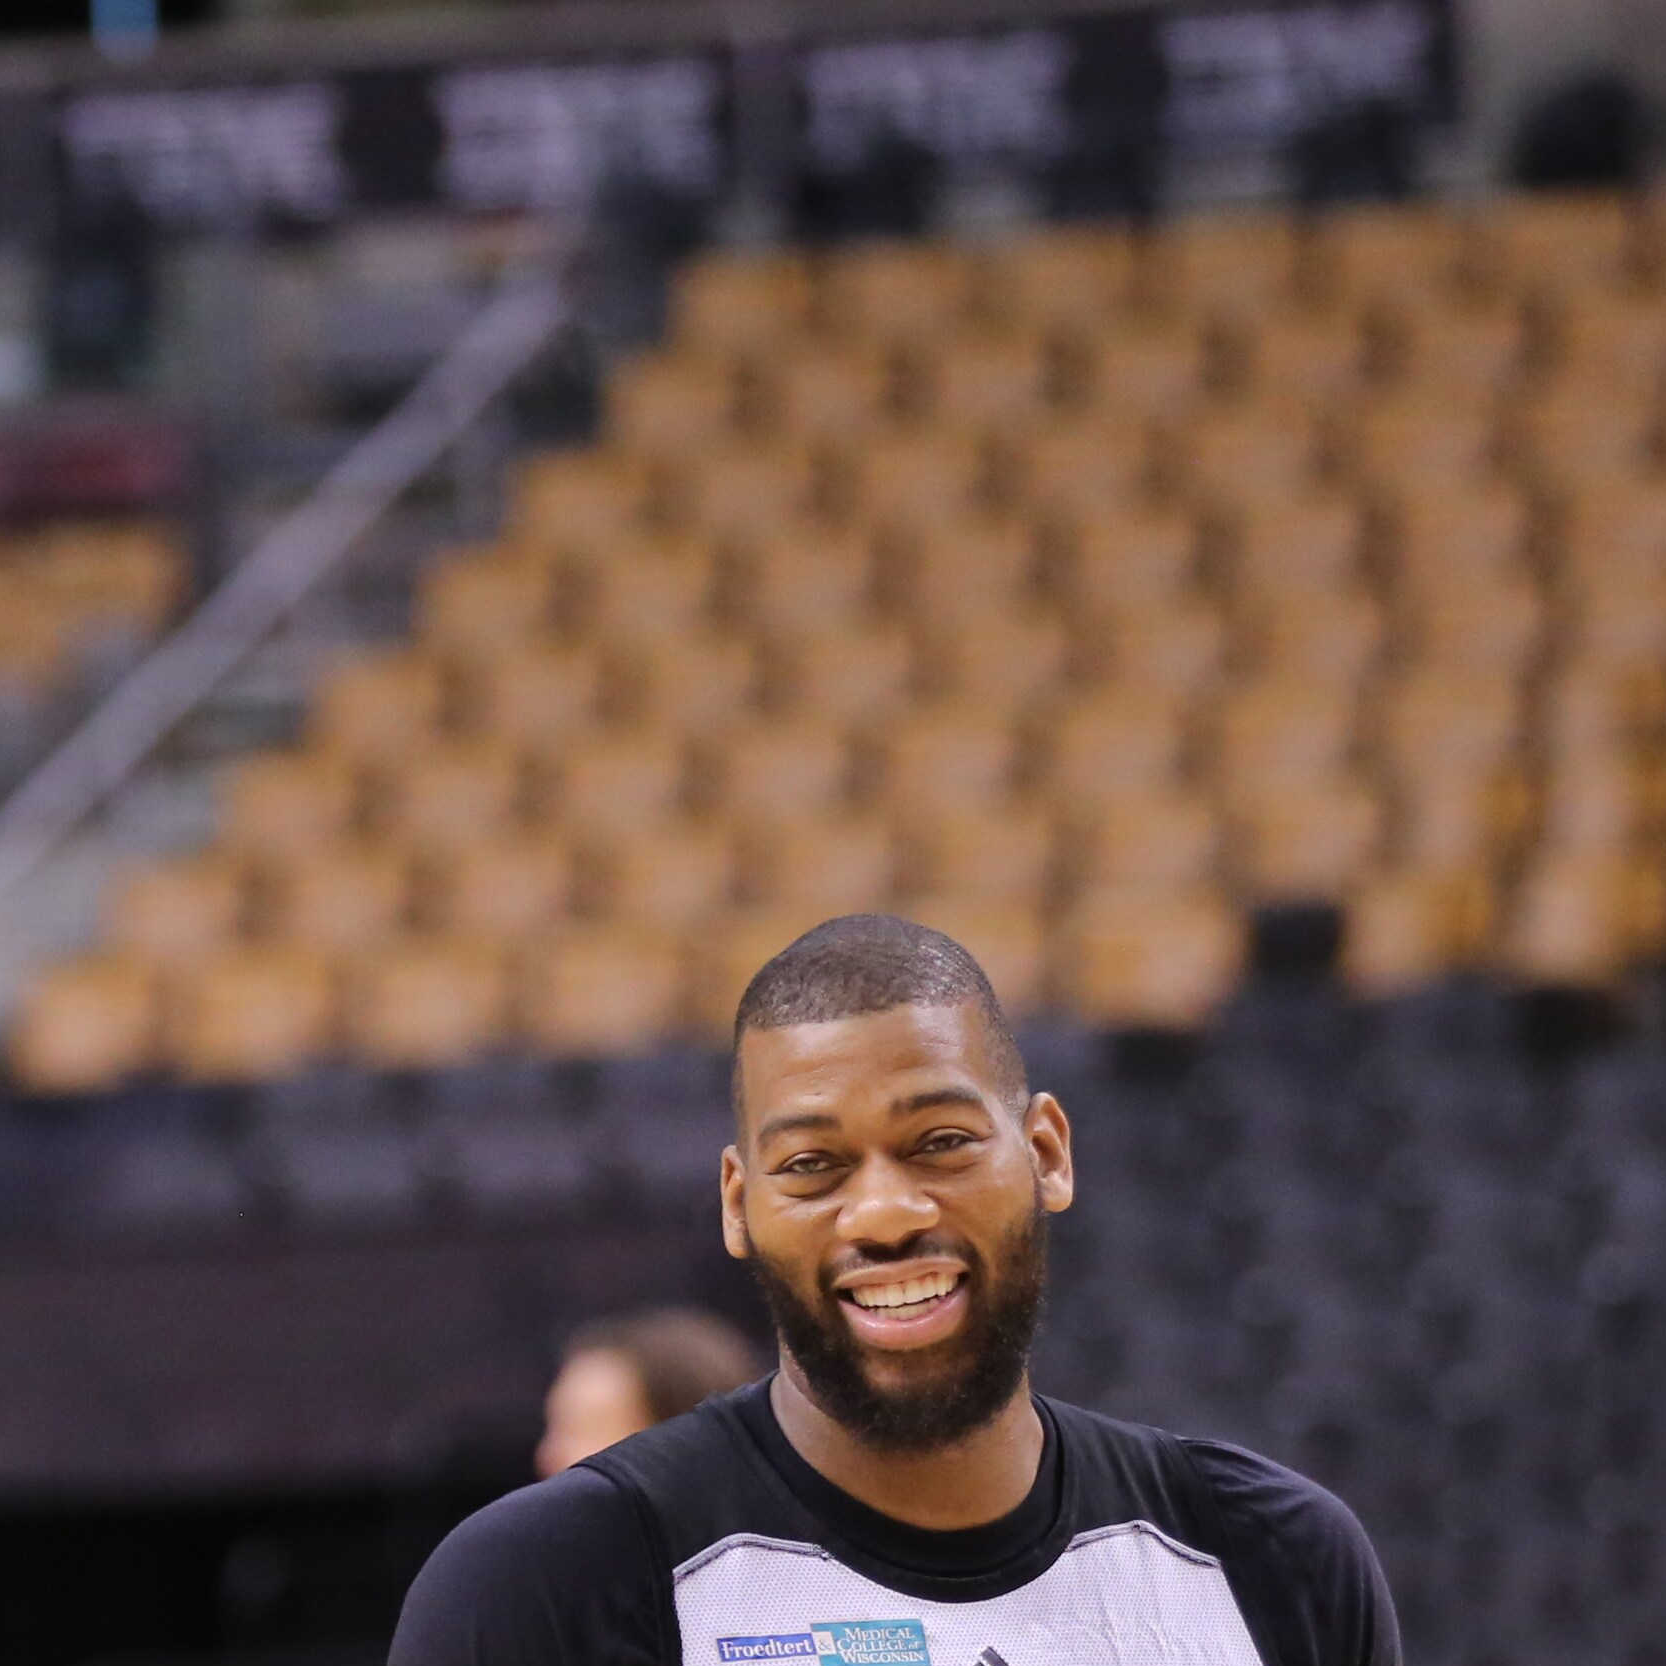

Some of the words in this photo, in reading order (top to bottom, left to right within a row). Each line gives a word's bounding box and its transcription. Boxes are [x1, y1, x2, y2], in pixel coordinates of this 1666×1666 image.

[845, 1628, 915, 1641] MEDICAL
[721, 1639, 813, 1660] Froedtert
[836, 1638, 907, 1653] COLLEGE
[839, 1651, 925, 1664] WISCONSIN
